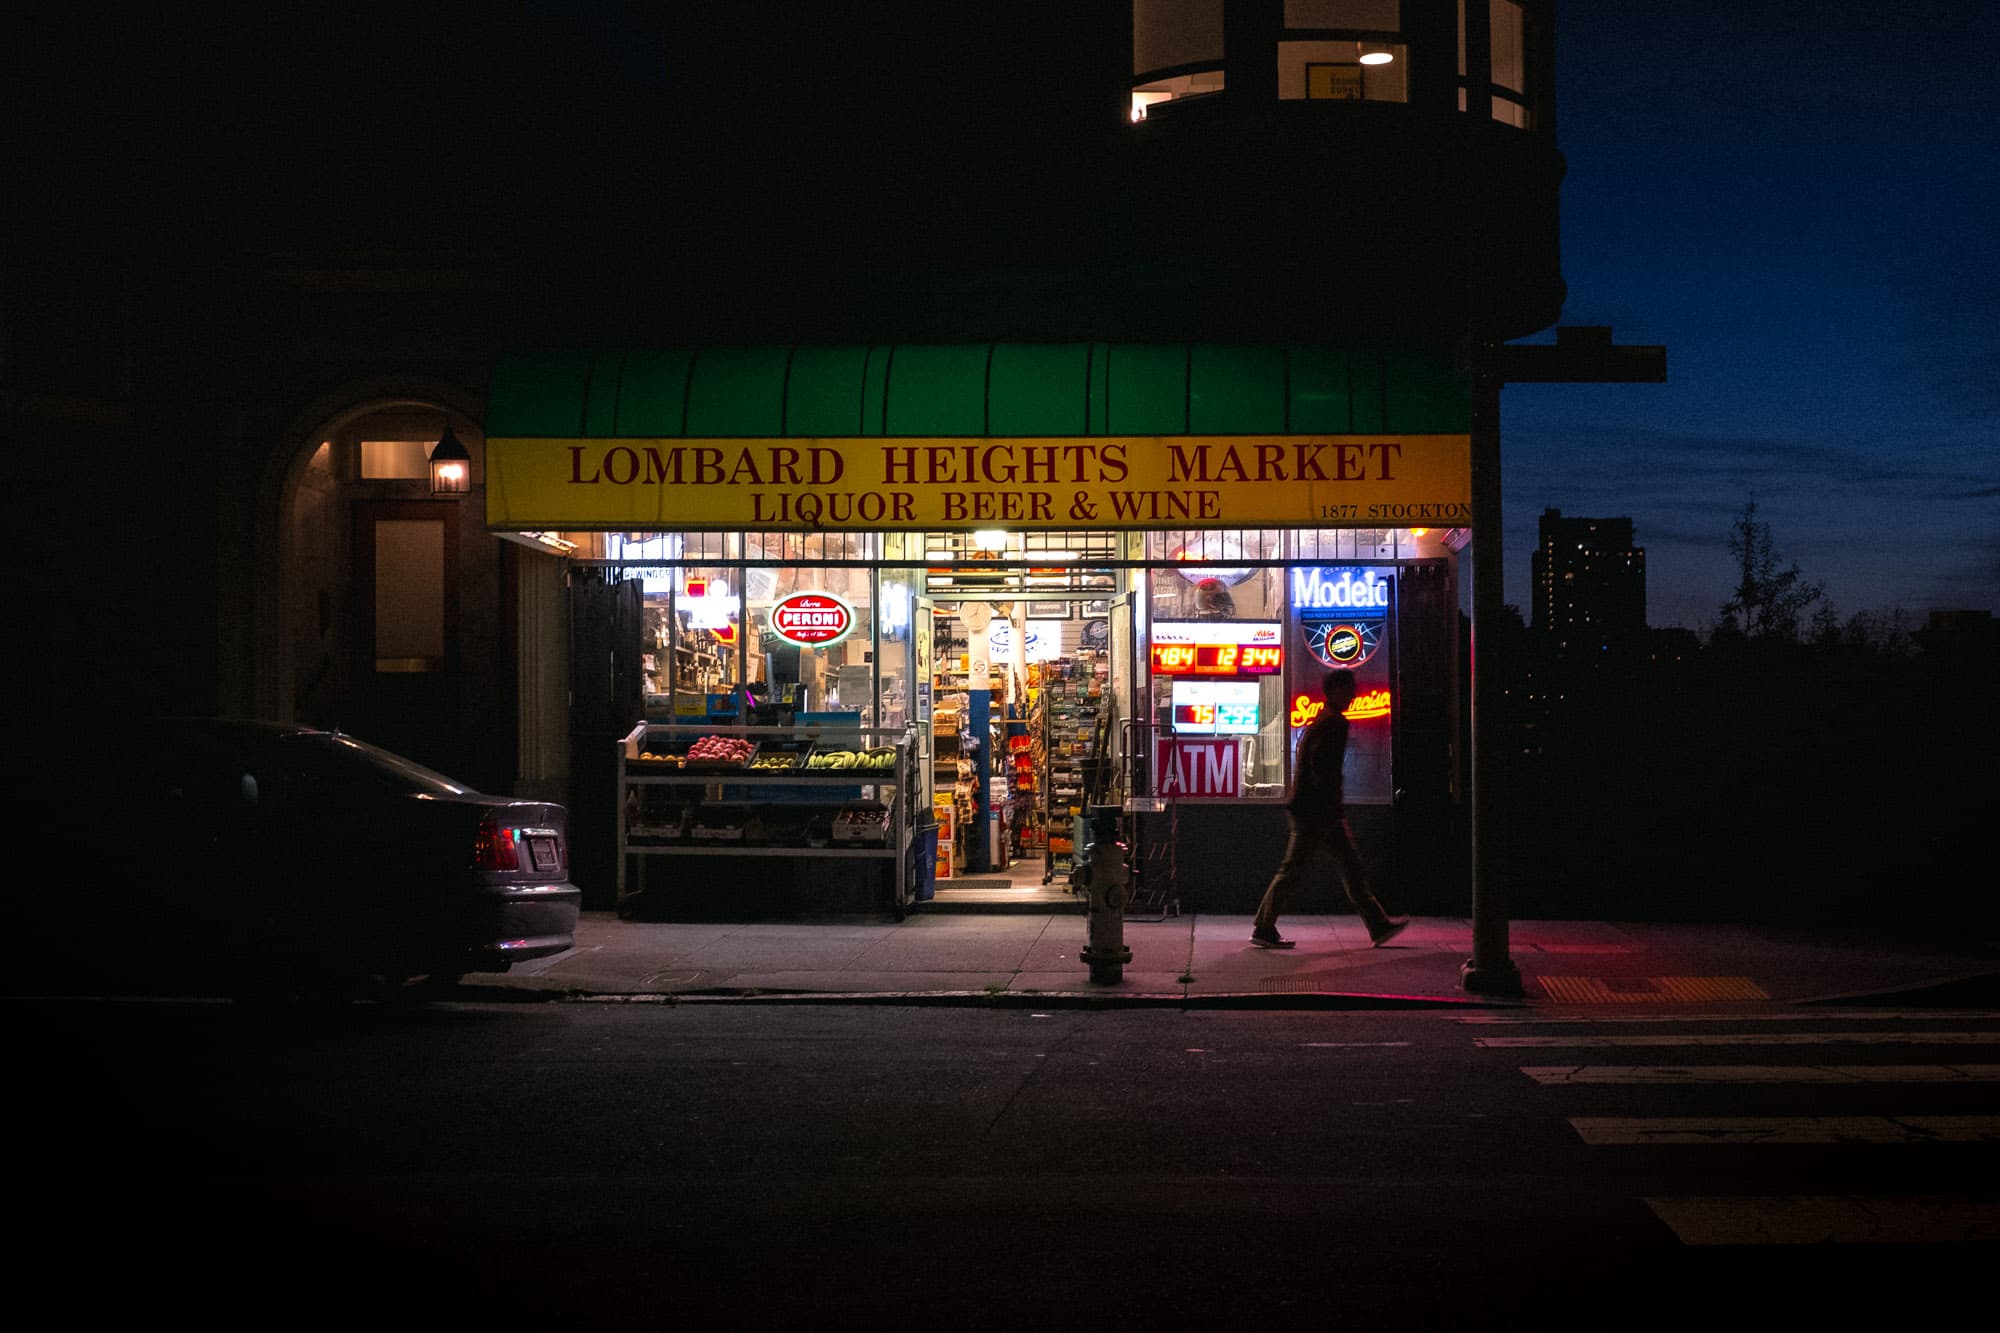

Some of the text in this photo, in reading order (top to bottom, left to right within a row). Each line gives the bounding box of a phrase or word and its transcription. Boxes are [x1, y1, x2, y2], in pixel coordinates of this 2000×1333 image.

[567, 443, 1402, 485] LOMBARD HEIGHTS MARKET
[750, 489, 1221, 528] LIQUOR BEER & WINE
[1321, 504, 1359, 519] 1877
[783, 613, 839, 625] PERONI
[1217, 648, 1237, 665] 12
[1242, 648, 1280, 666] 344
[1192, 705, 1214, 723] 75
[1162, 744, 1234, 794] ATM
